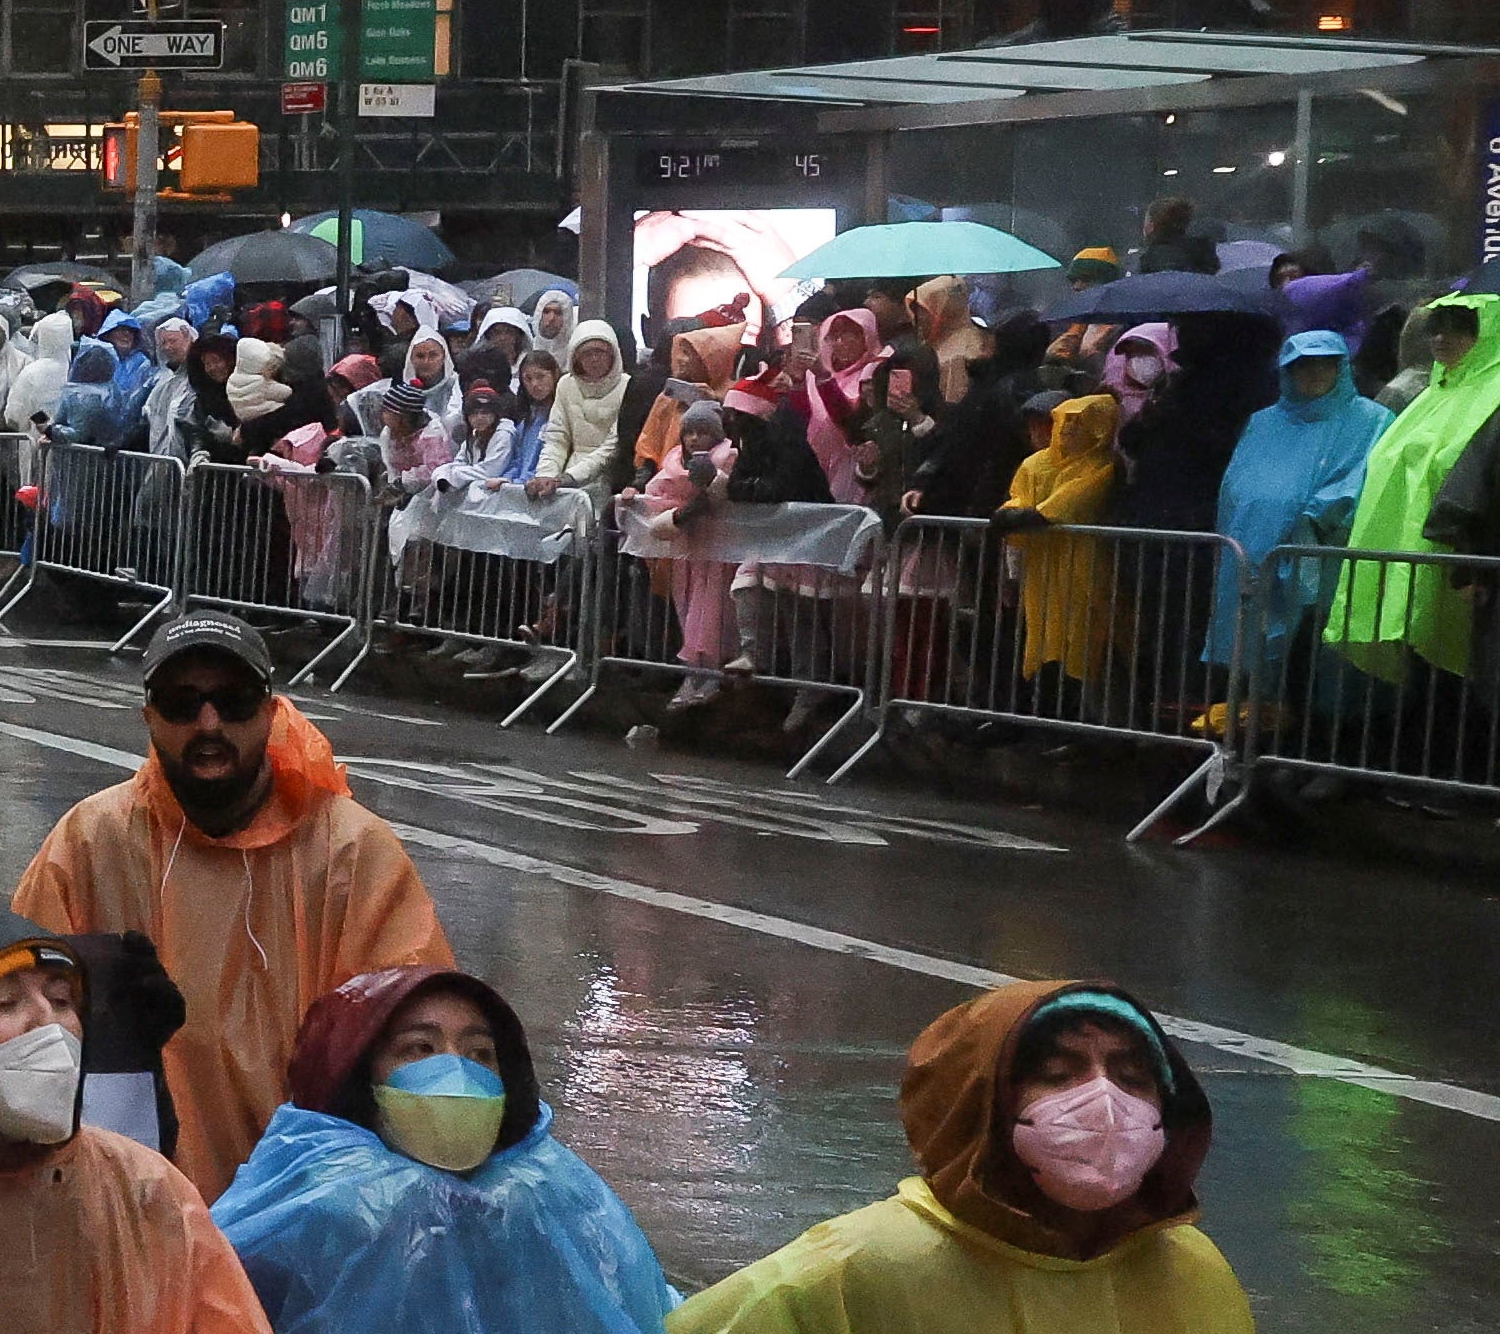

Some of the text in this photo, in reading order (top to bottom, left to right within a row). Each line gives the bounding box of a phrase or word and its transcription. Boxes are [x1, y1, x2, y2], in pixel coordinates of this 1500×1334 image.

[290, 4, 327, 24] QM1
[103, 34, 210, 54] ONE WAY
[289, 57, 328, 78] QM6
[659, 155, 702, 179] 9:21
